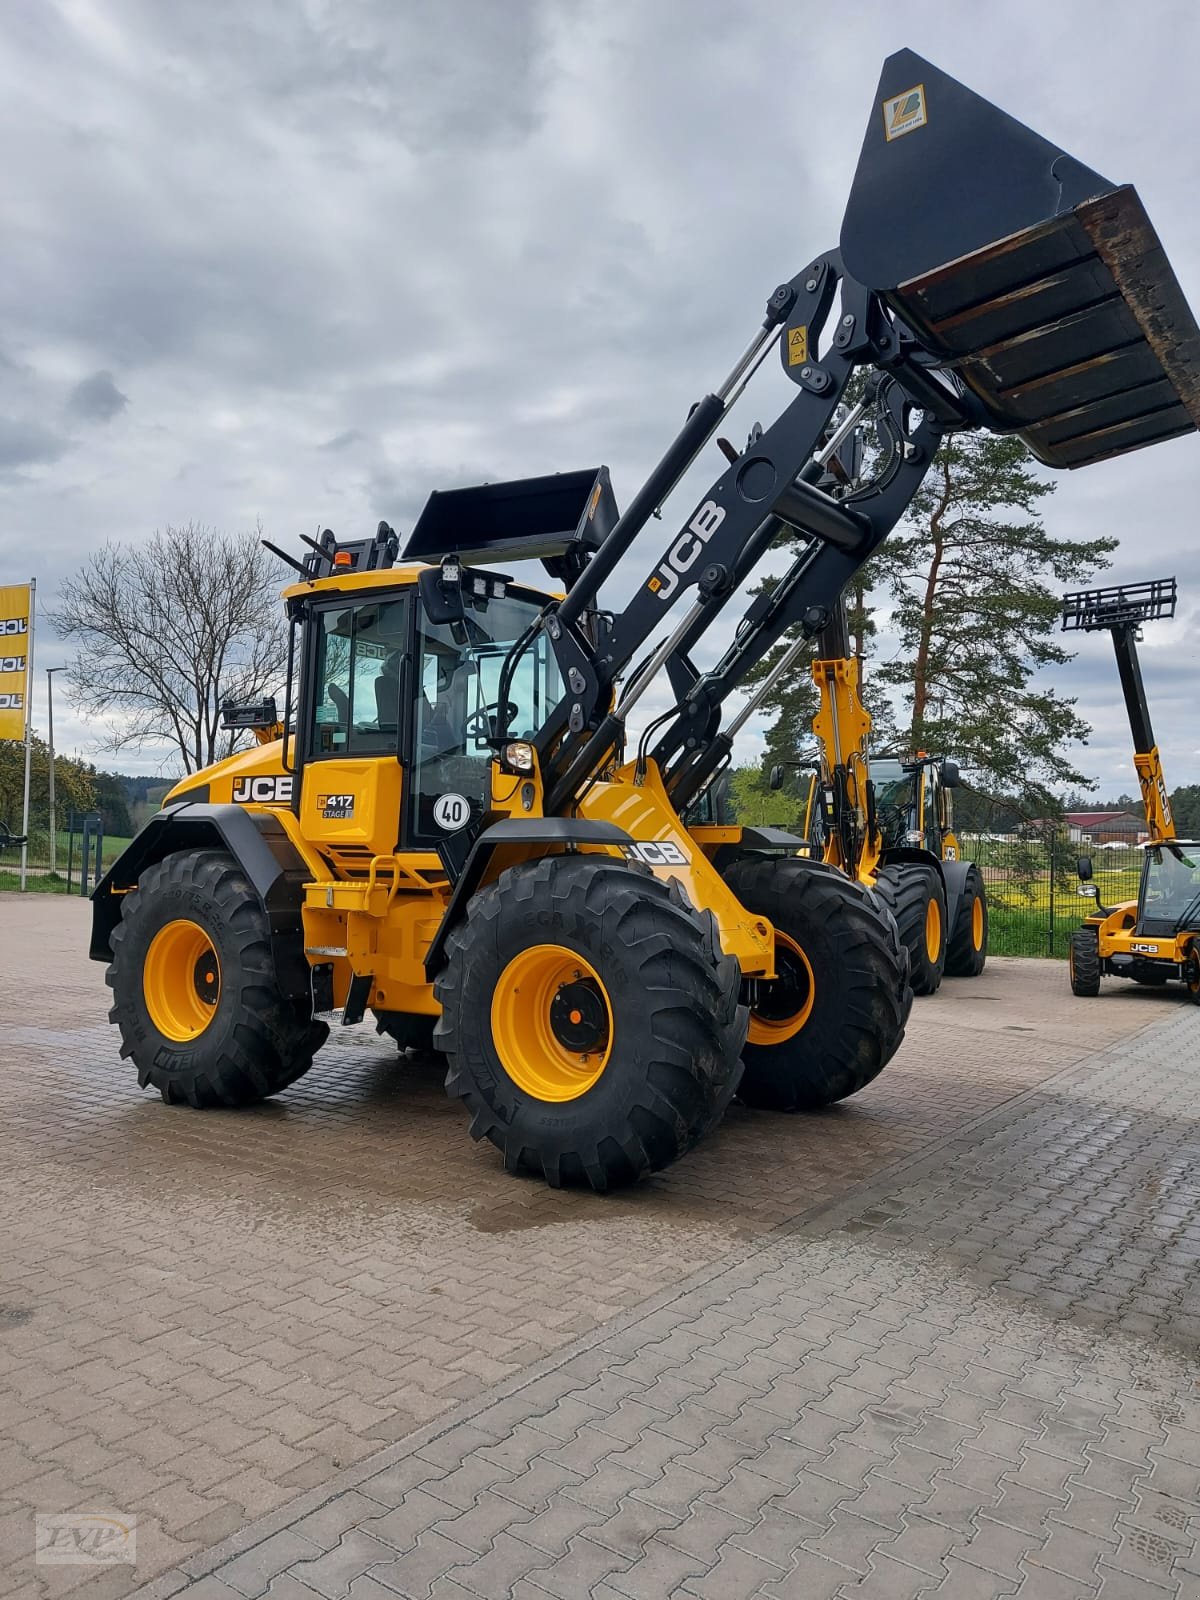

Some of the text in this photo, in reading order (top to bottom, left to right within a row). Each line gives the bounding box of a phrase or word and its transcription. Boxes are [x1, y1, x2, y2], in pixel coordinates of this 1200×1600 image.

[657, 500, 726, 600] JCB
[327, 795, 353, 808] 417
[323, 810, 345, 818] STAGE
[442, 801, 462, 822] 40
[626, 842, 687, 864] JCB
[1131, 944, 1158, 953] JCB
